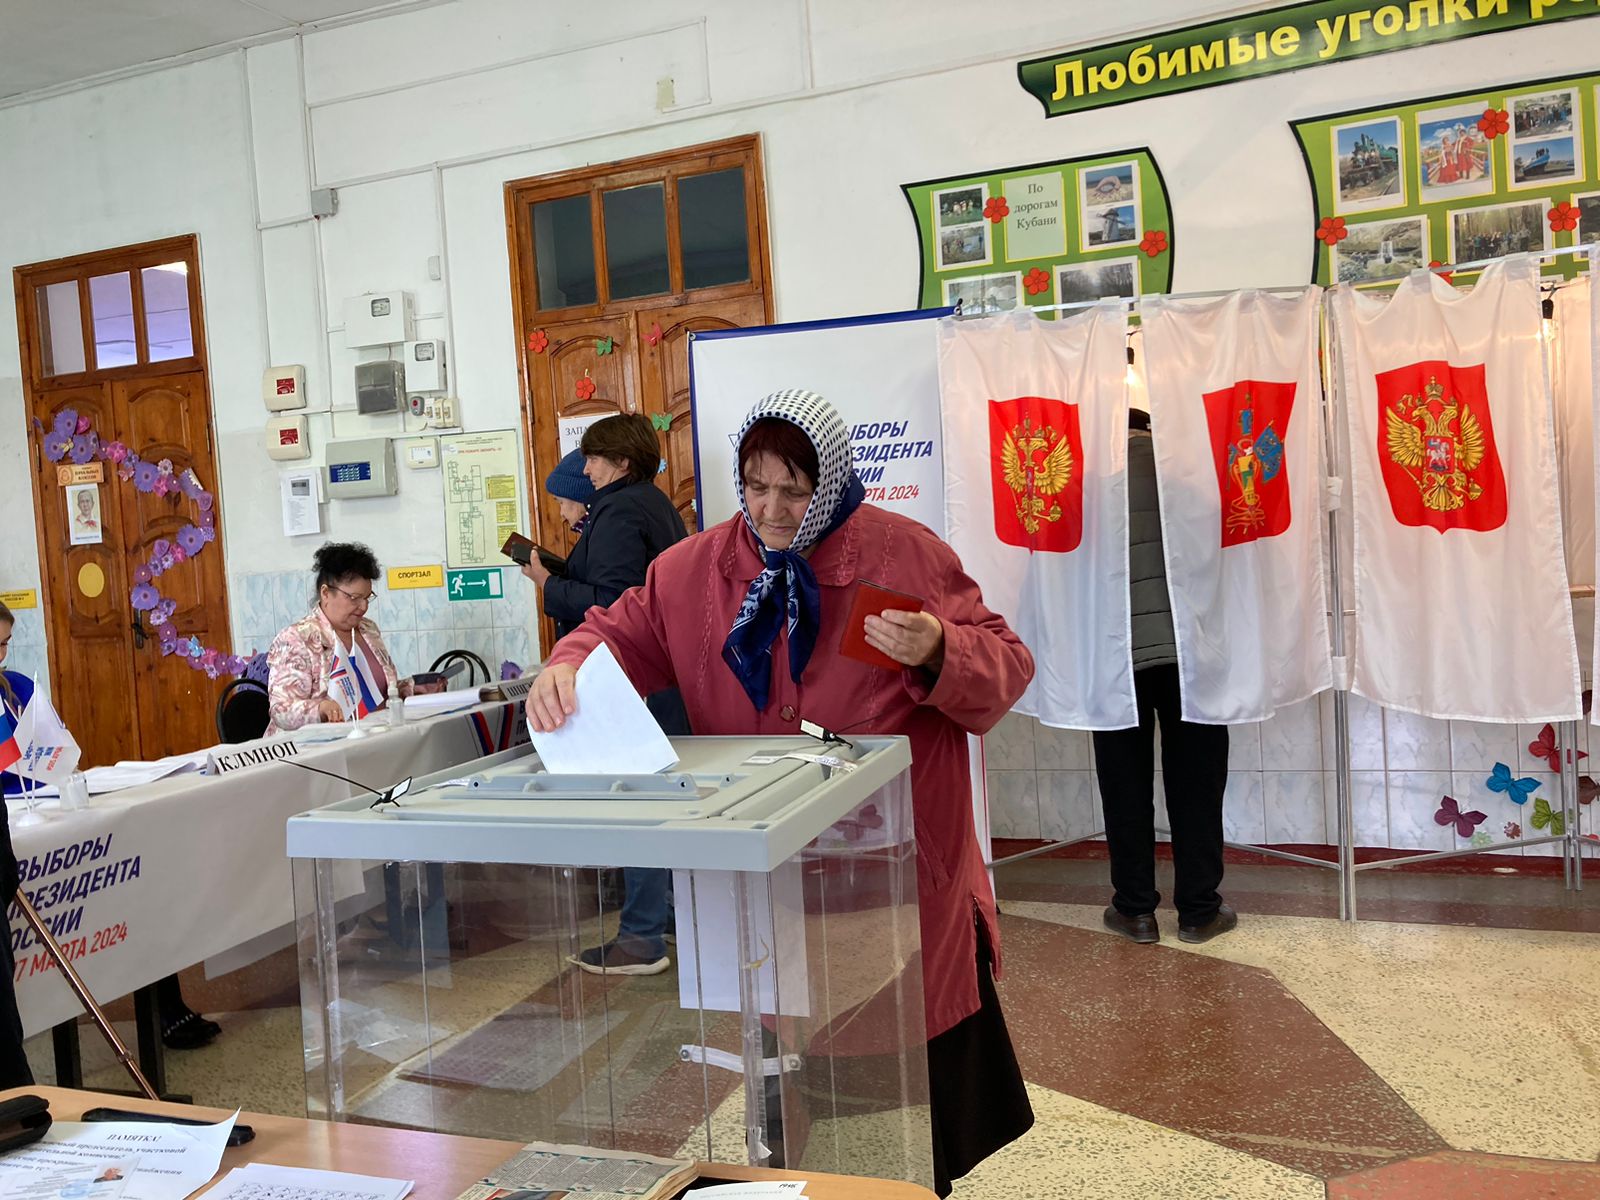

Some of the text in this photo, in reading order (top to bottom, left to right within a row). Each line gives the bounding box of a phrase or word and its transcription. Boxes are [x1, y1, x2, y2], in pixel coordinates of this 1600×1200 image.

[1052, 0, 1509, 100] Любимые уголки
[1028, 184, 1043, 194] По
[1014, 200, 1058, 213] дорогам
[1017, 216, 1057, 230] Кубани
[852, 441, 933, 463] ЗИДЕНТА
[887, 485, 919, 501] 2024
[398, 571, 432, 579] СПОРТЗАЛ
[218, 741, 298, 772] КЛМНОП
[17, 833, 113, 884] ВЫБОРЫ
[90, 921, 128, 954] 2024
